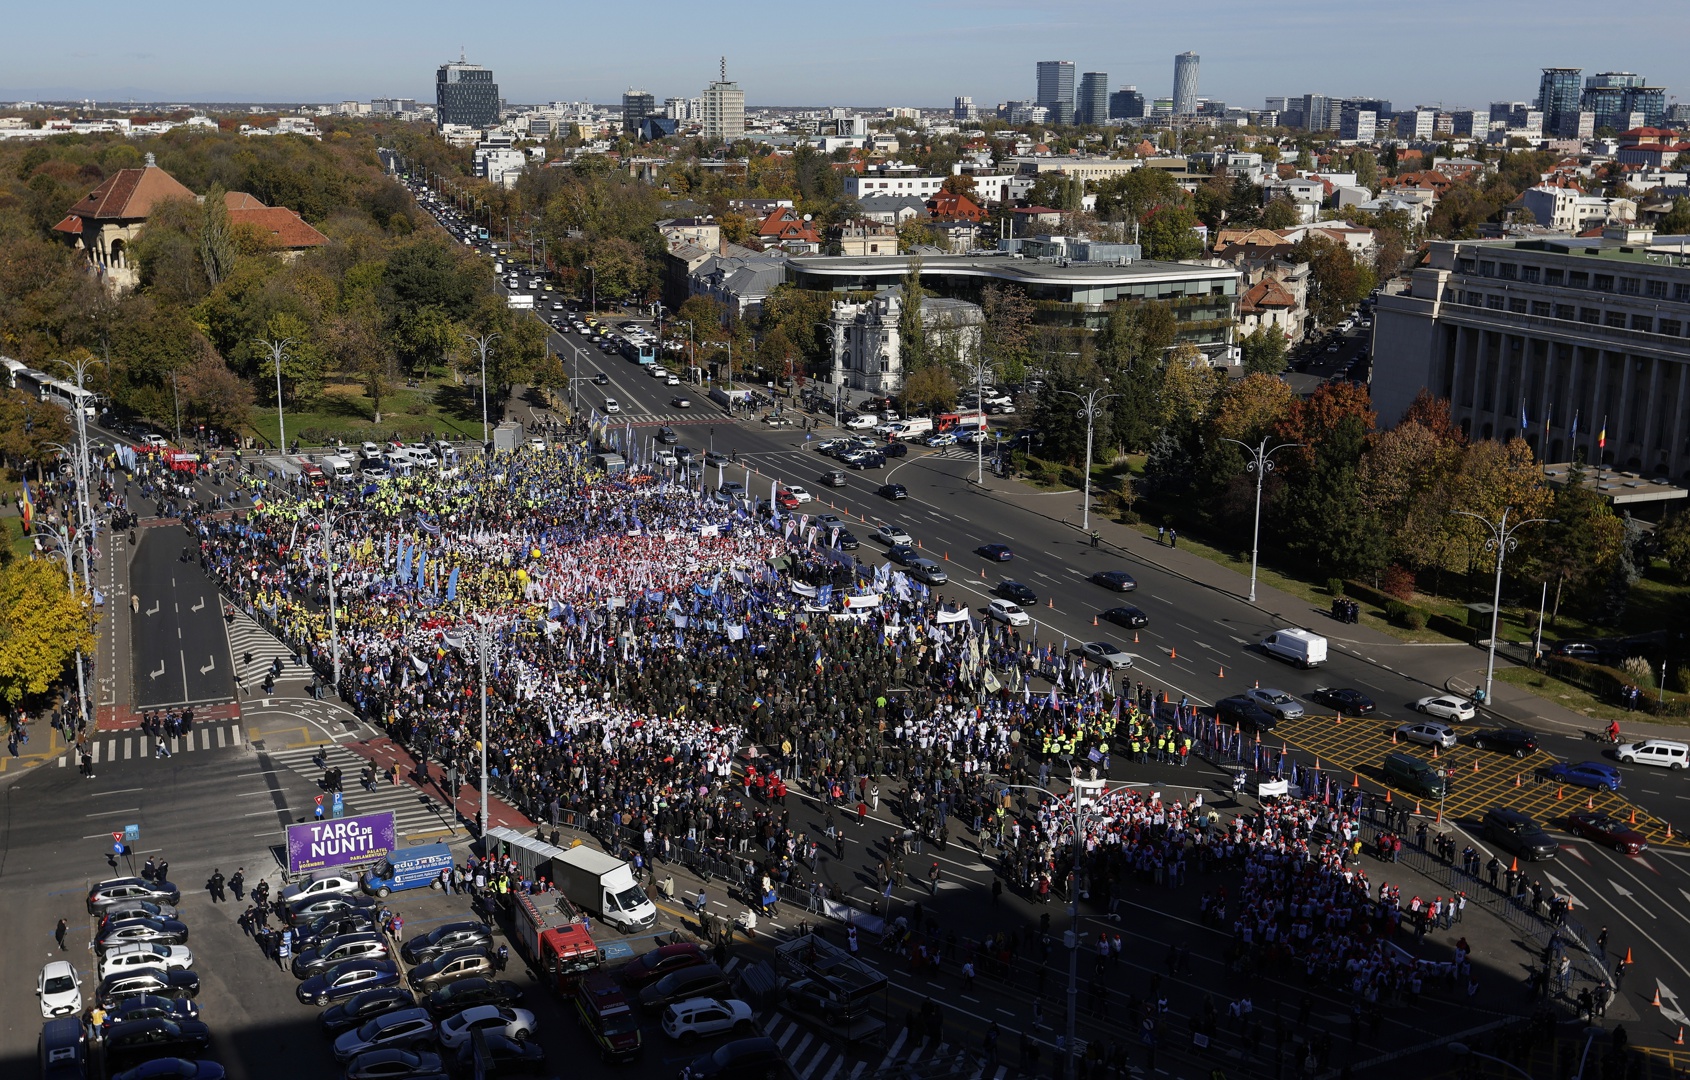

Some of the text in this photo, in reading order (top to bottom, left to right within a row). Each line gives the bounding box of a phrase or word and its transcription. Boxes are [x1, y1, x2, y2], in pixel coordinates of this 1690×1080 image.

[335, 794, 340, 803] P
[311, 821, 373, 842] TARG DE
[366, 847, 388, 855] PALATUL
[393, 860, 413, 869] edu
